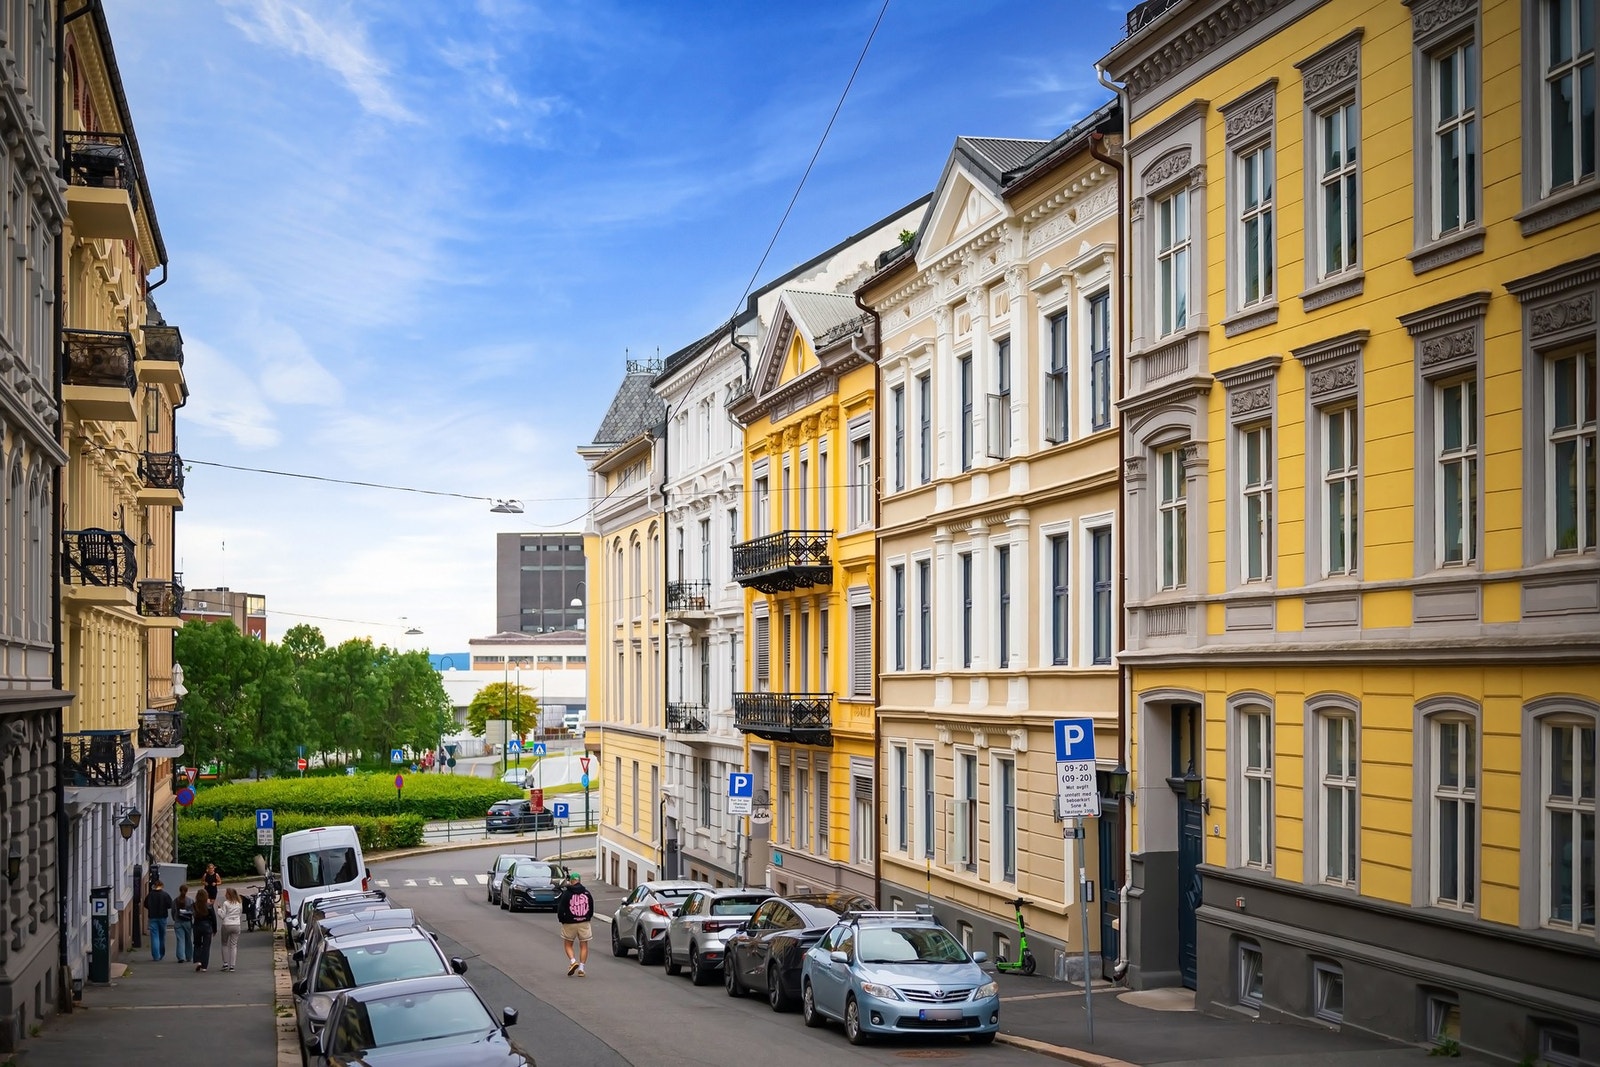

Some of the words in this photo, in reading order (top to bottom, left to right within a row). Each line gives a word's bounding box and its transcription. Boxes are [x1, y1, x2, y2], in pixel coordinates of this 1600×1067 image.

[1064, 725, 1084, 755] P
[735, 776, 747, 793] P
[557, 805, 565, 816] P
[260, 812, 269, 826] P
[570, 894, 588, 906] JUST
[96, 901, 104, 913] P
